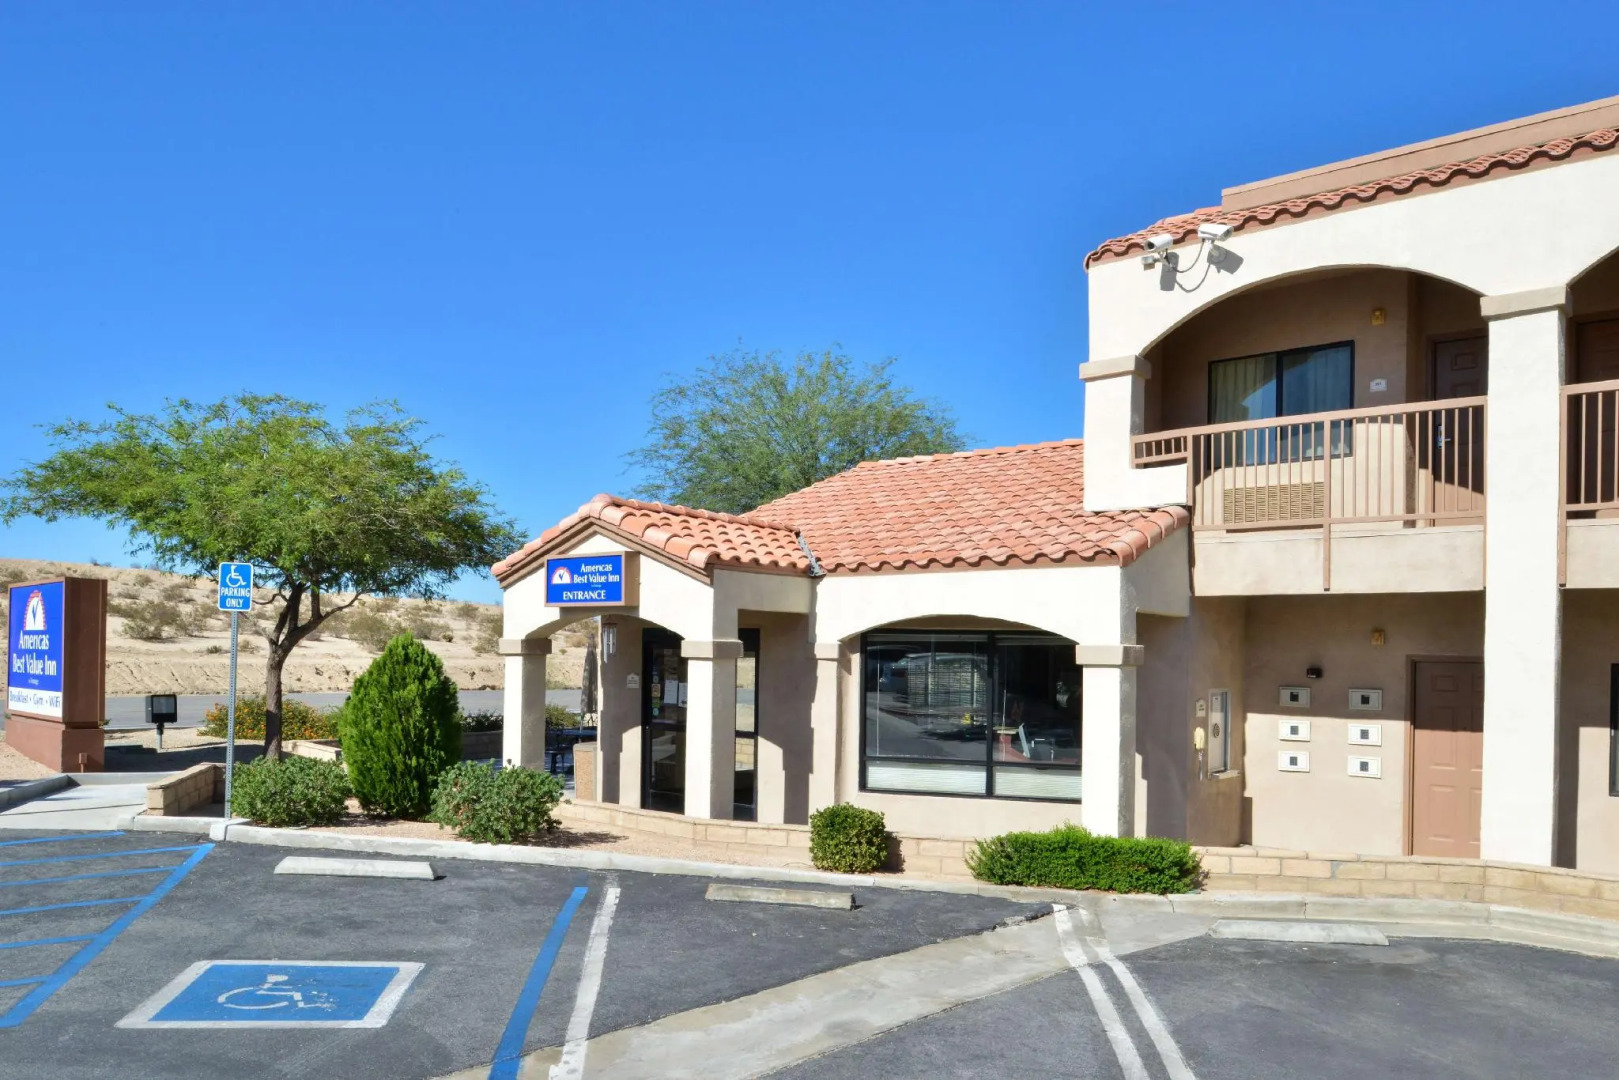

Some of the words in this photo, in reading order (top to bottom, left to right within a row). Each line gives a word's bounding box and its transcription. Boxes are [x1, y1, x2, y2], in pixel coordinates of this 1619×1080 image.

[580, 563, 612, 573] Americas
[574, 574, 588, 584] Best
[589, 573, 606, 582] Value
[608, 573, 620, 582] Inn
[220, 587, 250, 598] PARKING
[562, 590, 606, 600] ENTRANCE
[226, 598, 244, 608] ONLY
[18, 630, 49, 650] Americas
[12, 654, 25, 673] Best
[26, 652, 43, 675] Value
[44, 654, 56, 676] Inn
[10, 690, 28, 704] Breakfast
[33, 693, 44, 706] Gym
